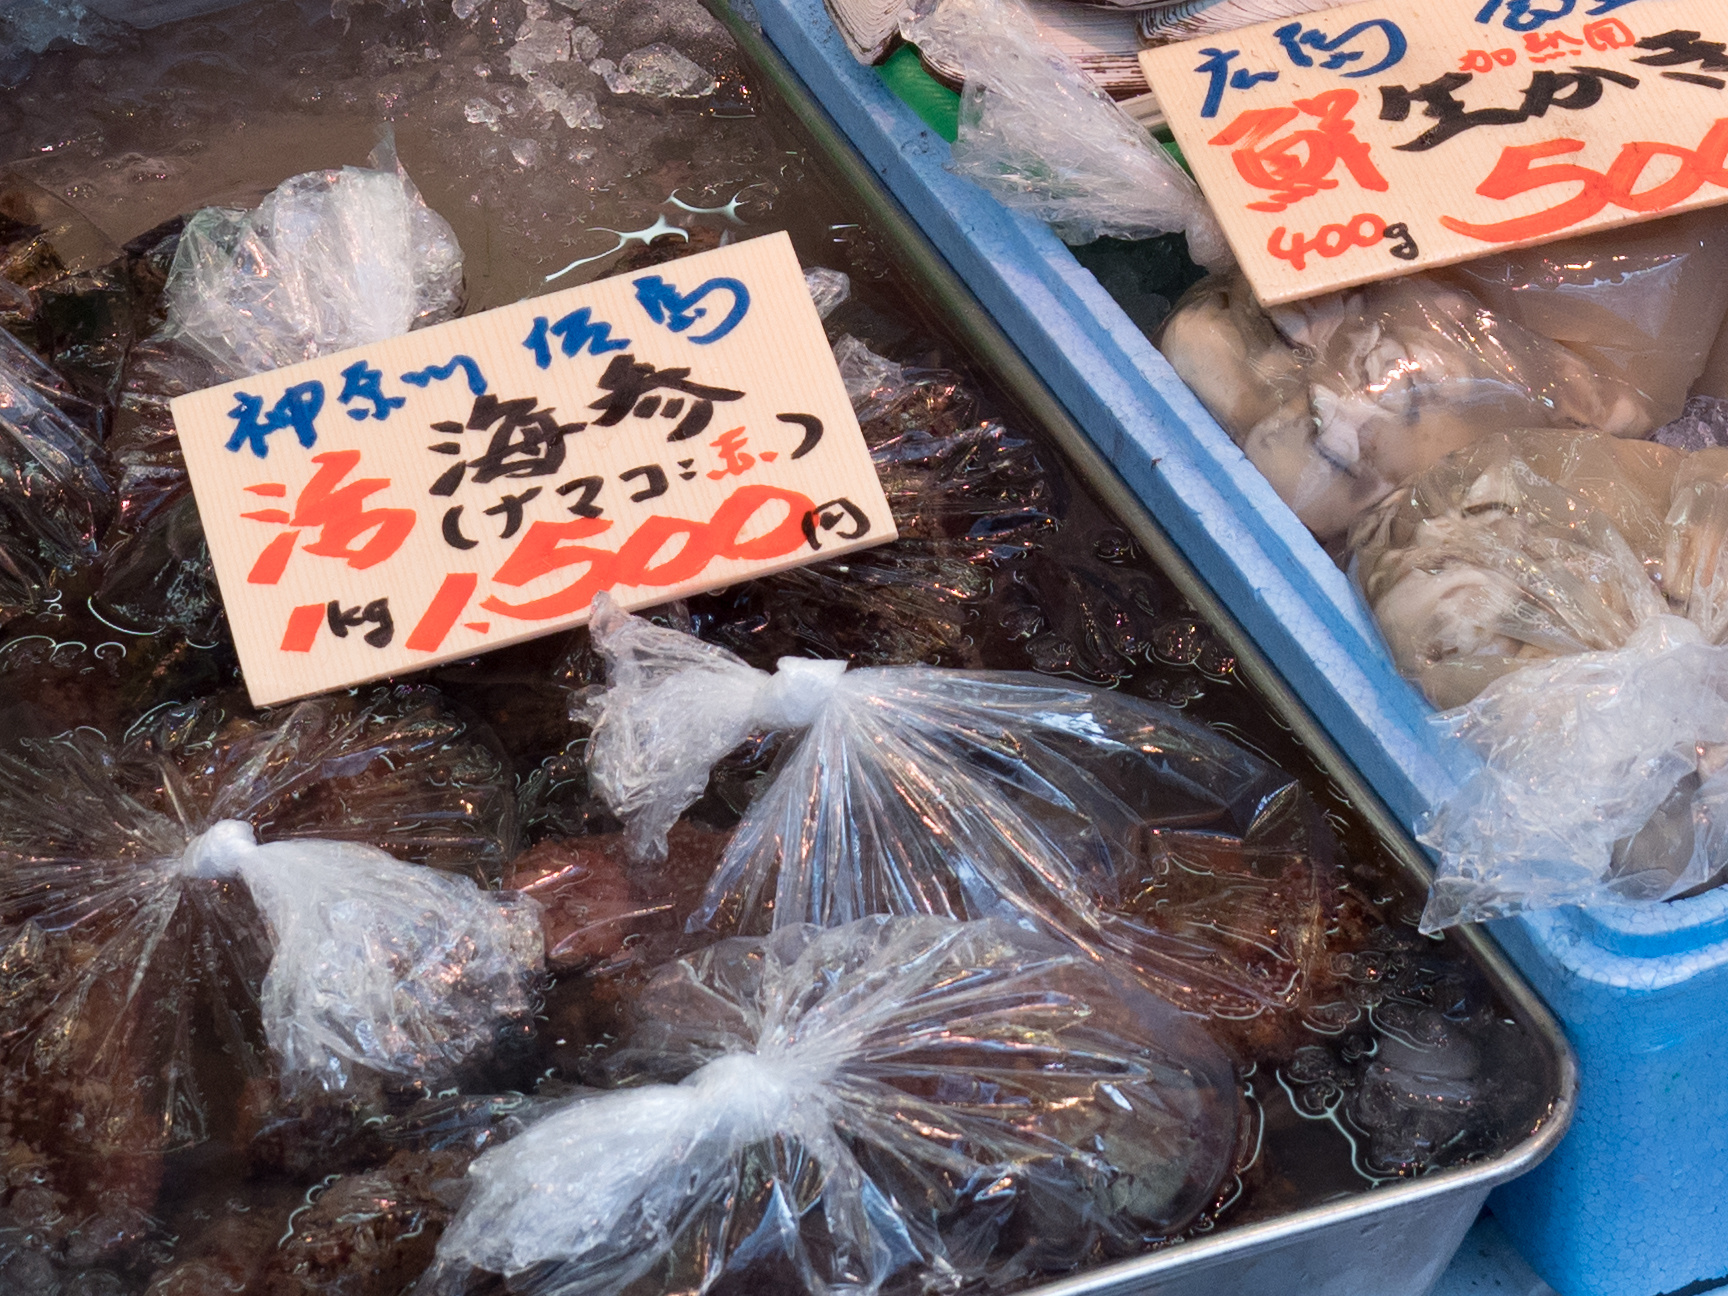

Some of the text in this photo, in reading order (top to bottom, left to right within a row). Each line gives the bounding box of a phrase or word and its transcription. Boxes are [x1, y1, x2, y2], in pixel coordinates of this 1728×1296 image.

[1207, 88, 1390, 213] 鮮
[1268, 213, 1420, 270] 400g
[225, 354, 488, 459] 神奈川
[240, 450, 417, 584] 活
